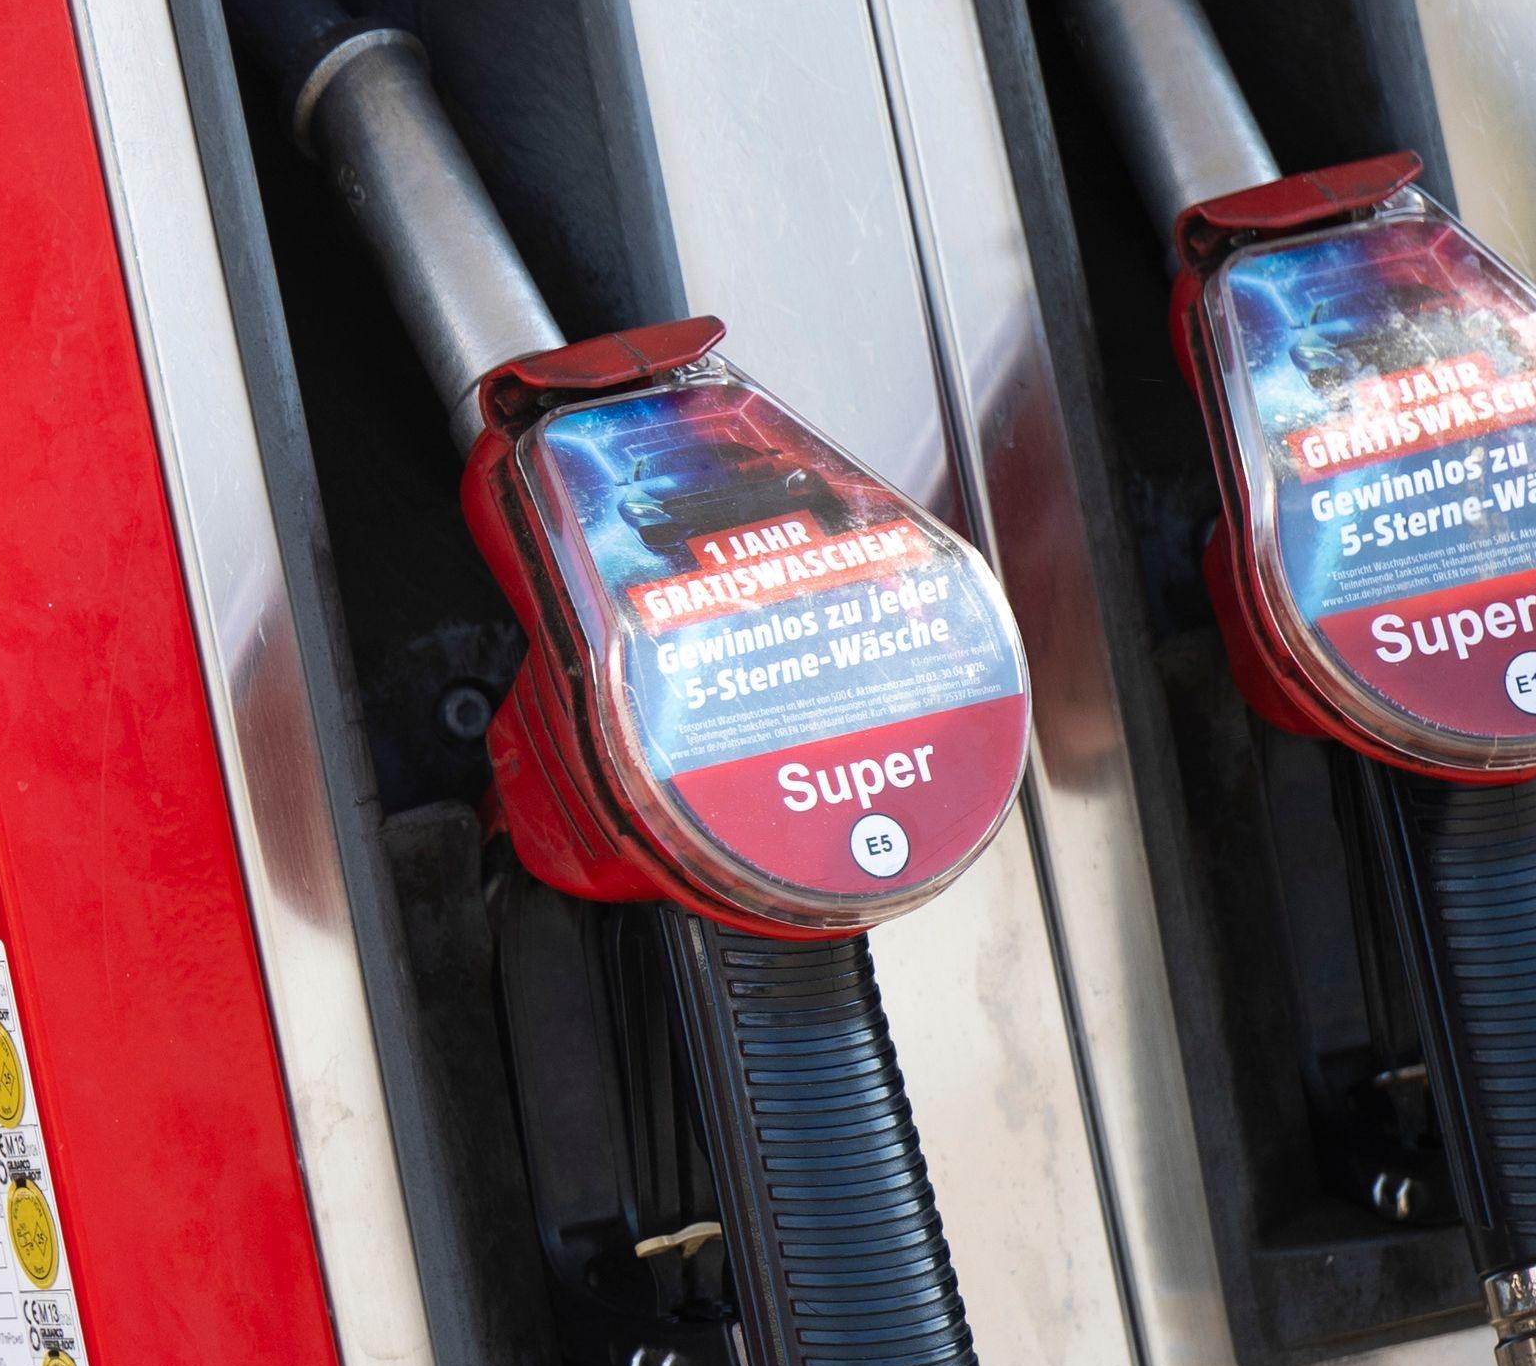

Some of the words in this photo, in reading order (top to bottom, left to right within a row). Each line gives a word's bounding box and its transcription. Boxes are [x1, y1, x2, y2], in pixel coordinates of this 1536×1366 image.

[1397, 362, 1482, 405] JAHR
[1311, 451, 1482, 522] Gewinnlos
[1489, 440, 1528, 474] zu
[704, 542, 727, 565] 1
[728, 521, 812, 561] JAHR
[1457, 540, 1477, 554] Wert
[1339, 573, 1394, 592] Teilnehmende
[1433, 569, 1459, 582] ORLEN
[657, 611, 819, 674] Gewinnlos
[825, 598, 863, 631] zu
[868, 573, 951, 623] jeder
[685, 618, 950, 709] 5-Sterne-Wäsche
[796, 696, 816, 710] Wert
[776, 743, 935, 813] Super
[865, 833, 894, 857] E5
